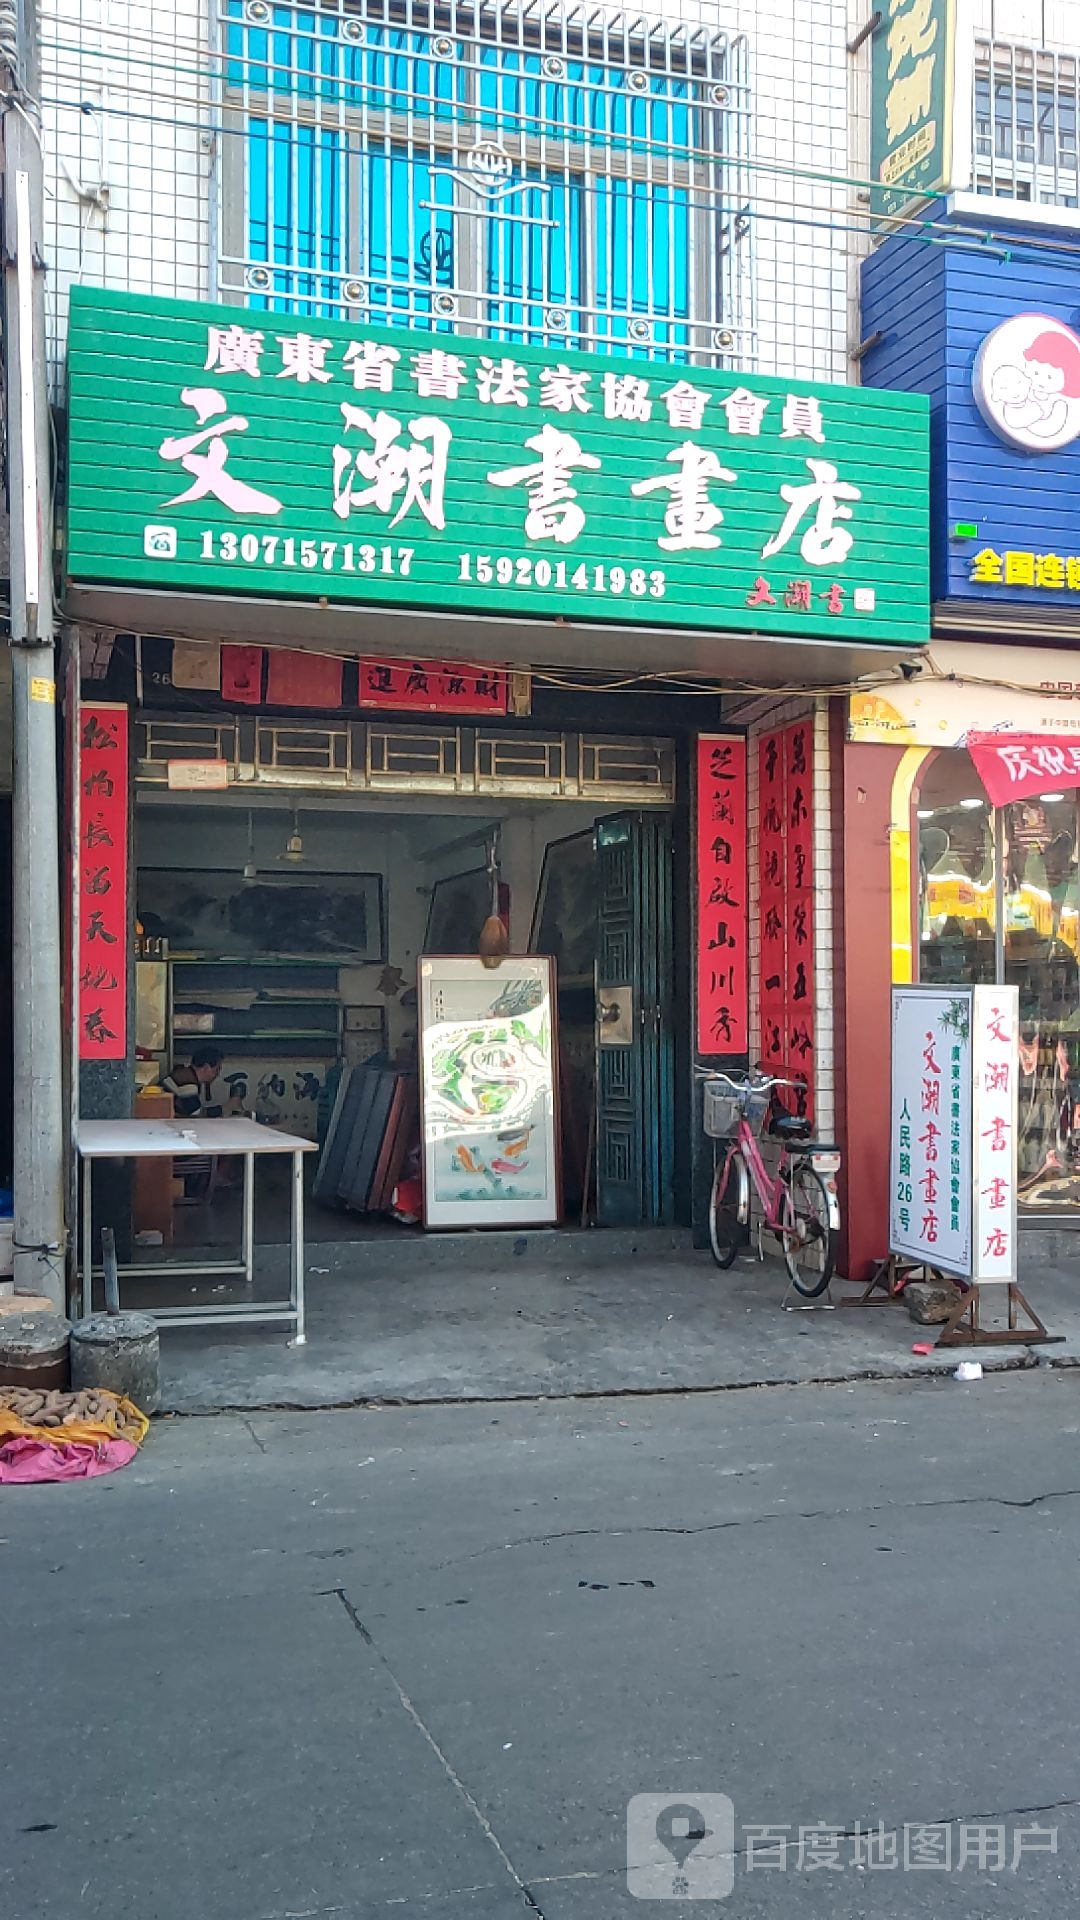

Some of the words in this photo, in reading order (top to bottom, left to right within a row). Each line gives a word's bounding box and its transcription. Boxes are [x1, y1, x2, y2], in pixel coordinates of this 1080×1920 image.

[204, 324, 826, 443] 廣東省書法家協會會員
[159, 387, 862, 567] 文潮書畫店
[200, 530, 415, 576] 13071571317
[457, 553, 667, 598] 15920141983
[897, 1098, 913, 1232] 人民路26号
[917, 1030, 942, 1243] 文潮書畫店
[980, 1007, 1012, 1257] 文潮書畫店
